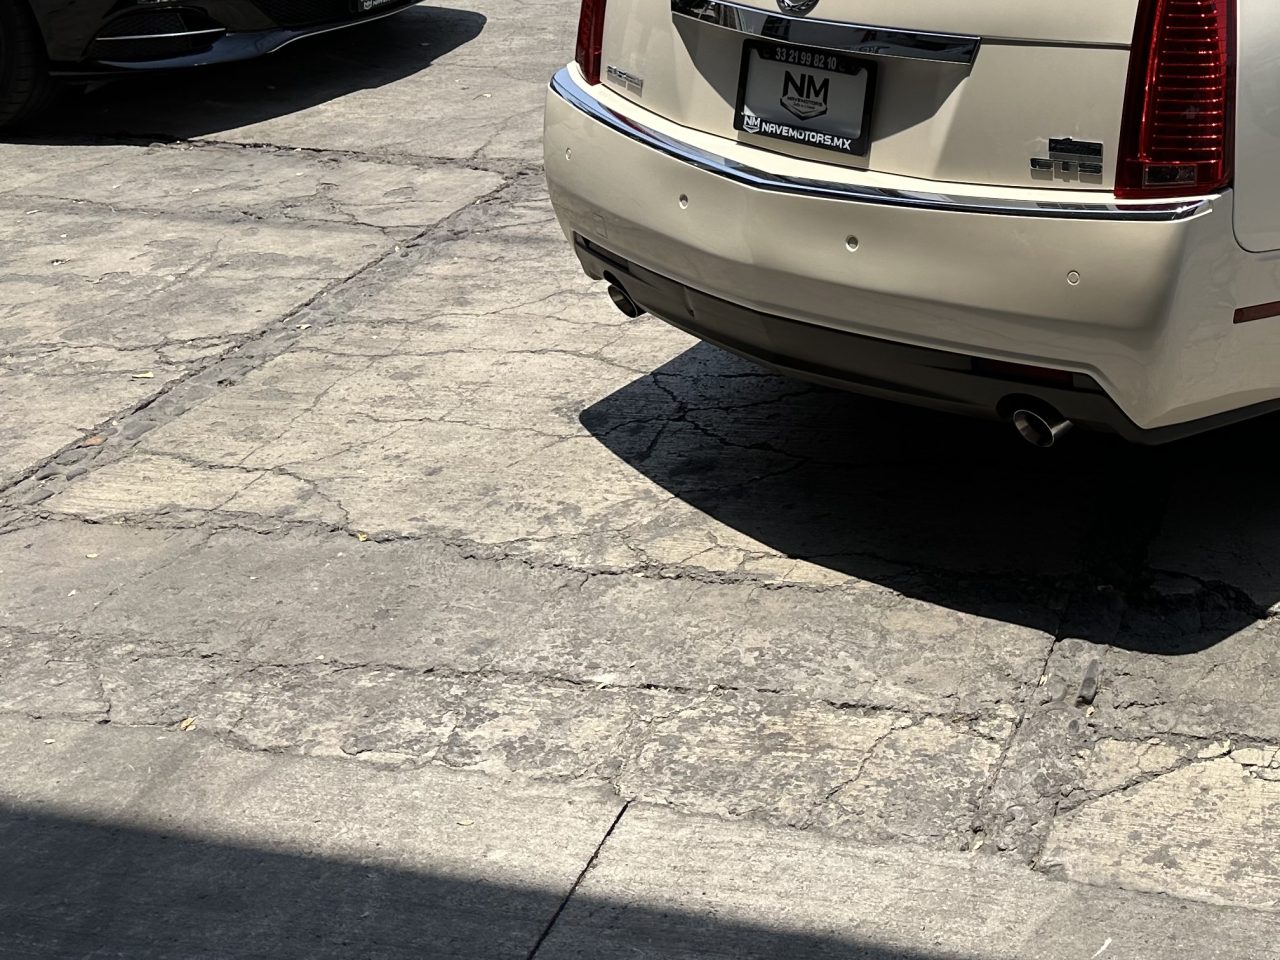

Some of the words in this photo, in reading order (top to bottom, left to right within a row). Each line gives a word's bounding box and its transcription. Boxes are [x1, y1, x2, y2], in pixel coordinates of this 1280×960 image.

[775, 47, 786, 61] 33
[788, 49, 798, 63] 21
[800, 51, 812, 65] 99
[813, 54, 824, 68] 82
[827, 56, 837, 70] 10
[782, 70, 830, 106] NM
[761, 122, 852, 150] NAVEMOTORS.MX
